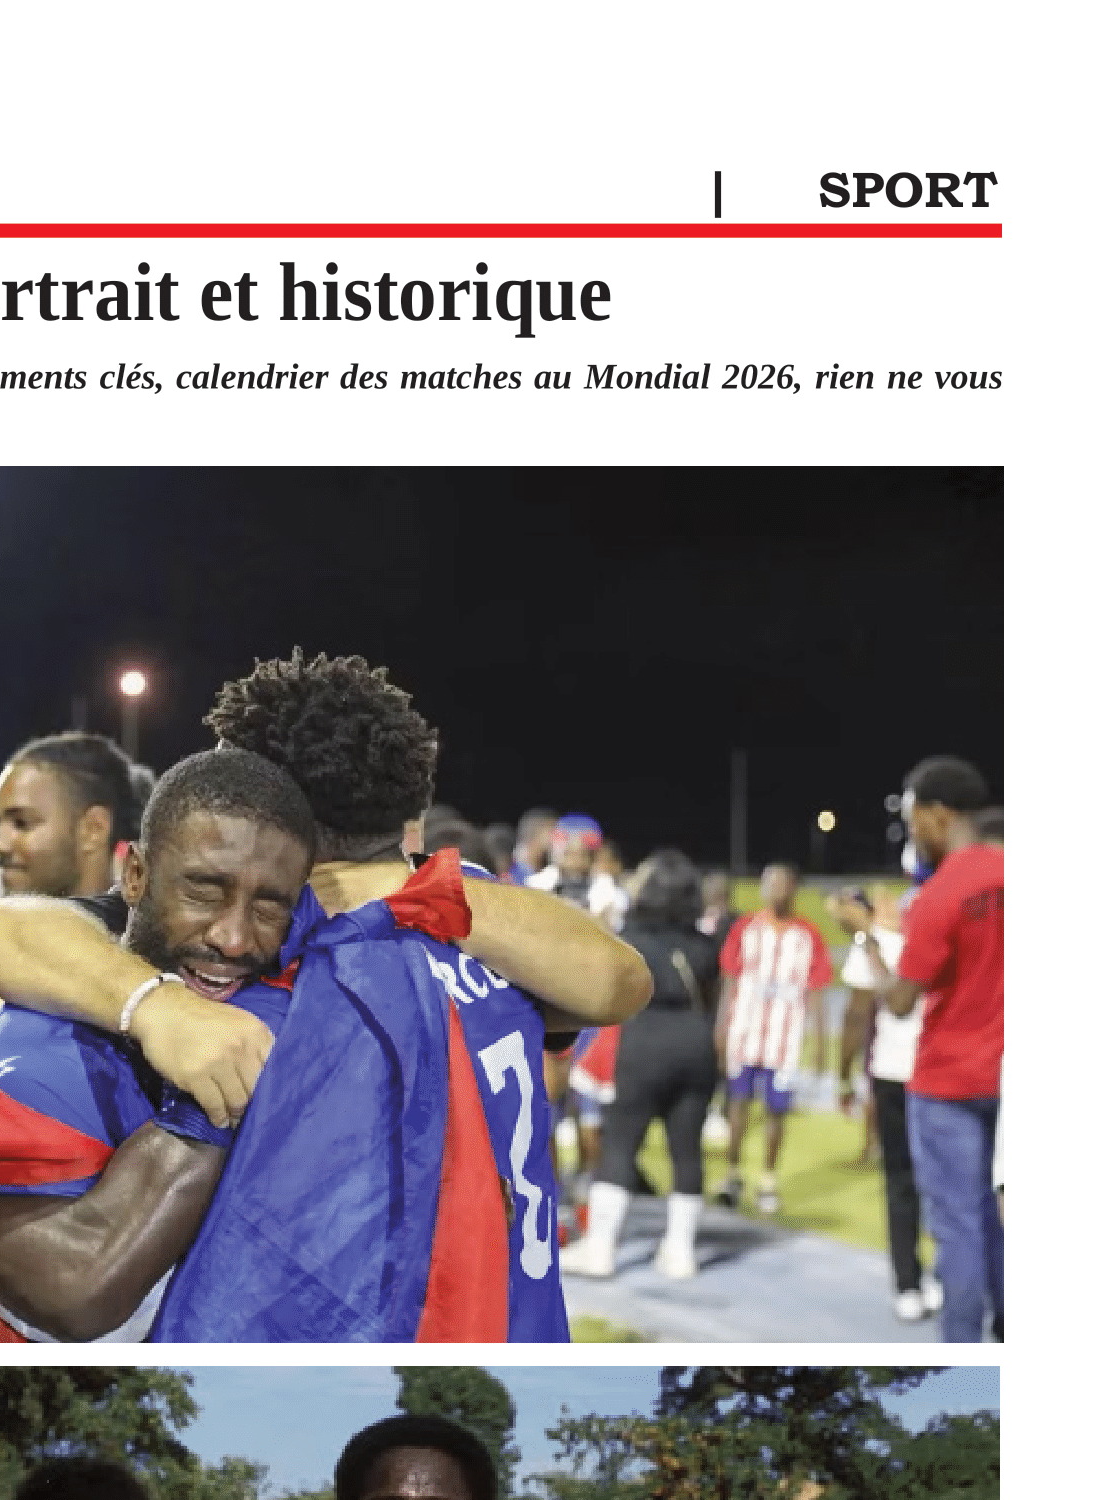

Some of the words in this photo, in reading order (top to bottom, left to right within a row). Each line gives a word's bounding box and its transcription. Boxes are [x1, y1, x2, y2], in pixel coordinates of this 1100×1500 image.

[820, 172, 998, 208] SPORT
[202, 273, 258, 321] et
[280, 262, 610, 338] historique
[100, 363, 162, 394] clés,
[176, 363, 329, 389] calendrier
[340, 363, 387, 389] des
[401, 363, 521, 389] matches
[534, 371, 571, 389] au
[584, 363, 710, 389] Mondial
[722, 364, 800, 394] 2026,
[816, 363, 873, 389] rien
[888, 371, 922, 389] ne
[935, 371, 1002, 389] vous
